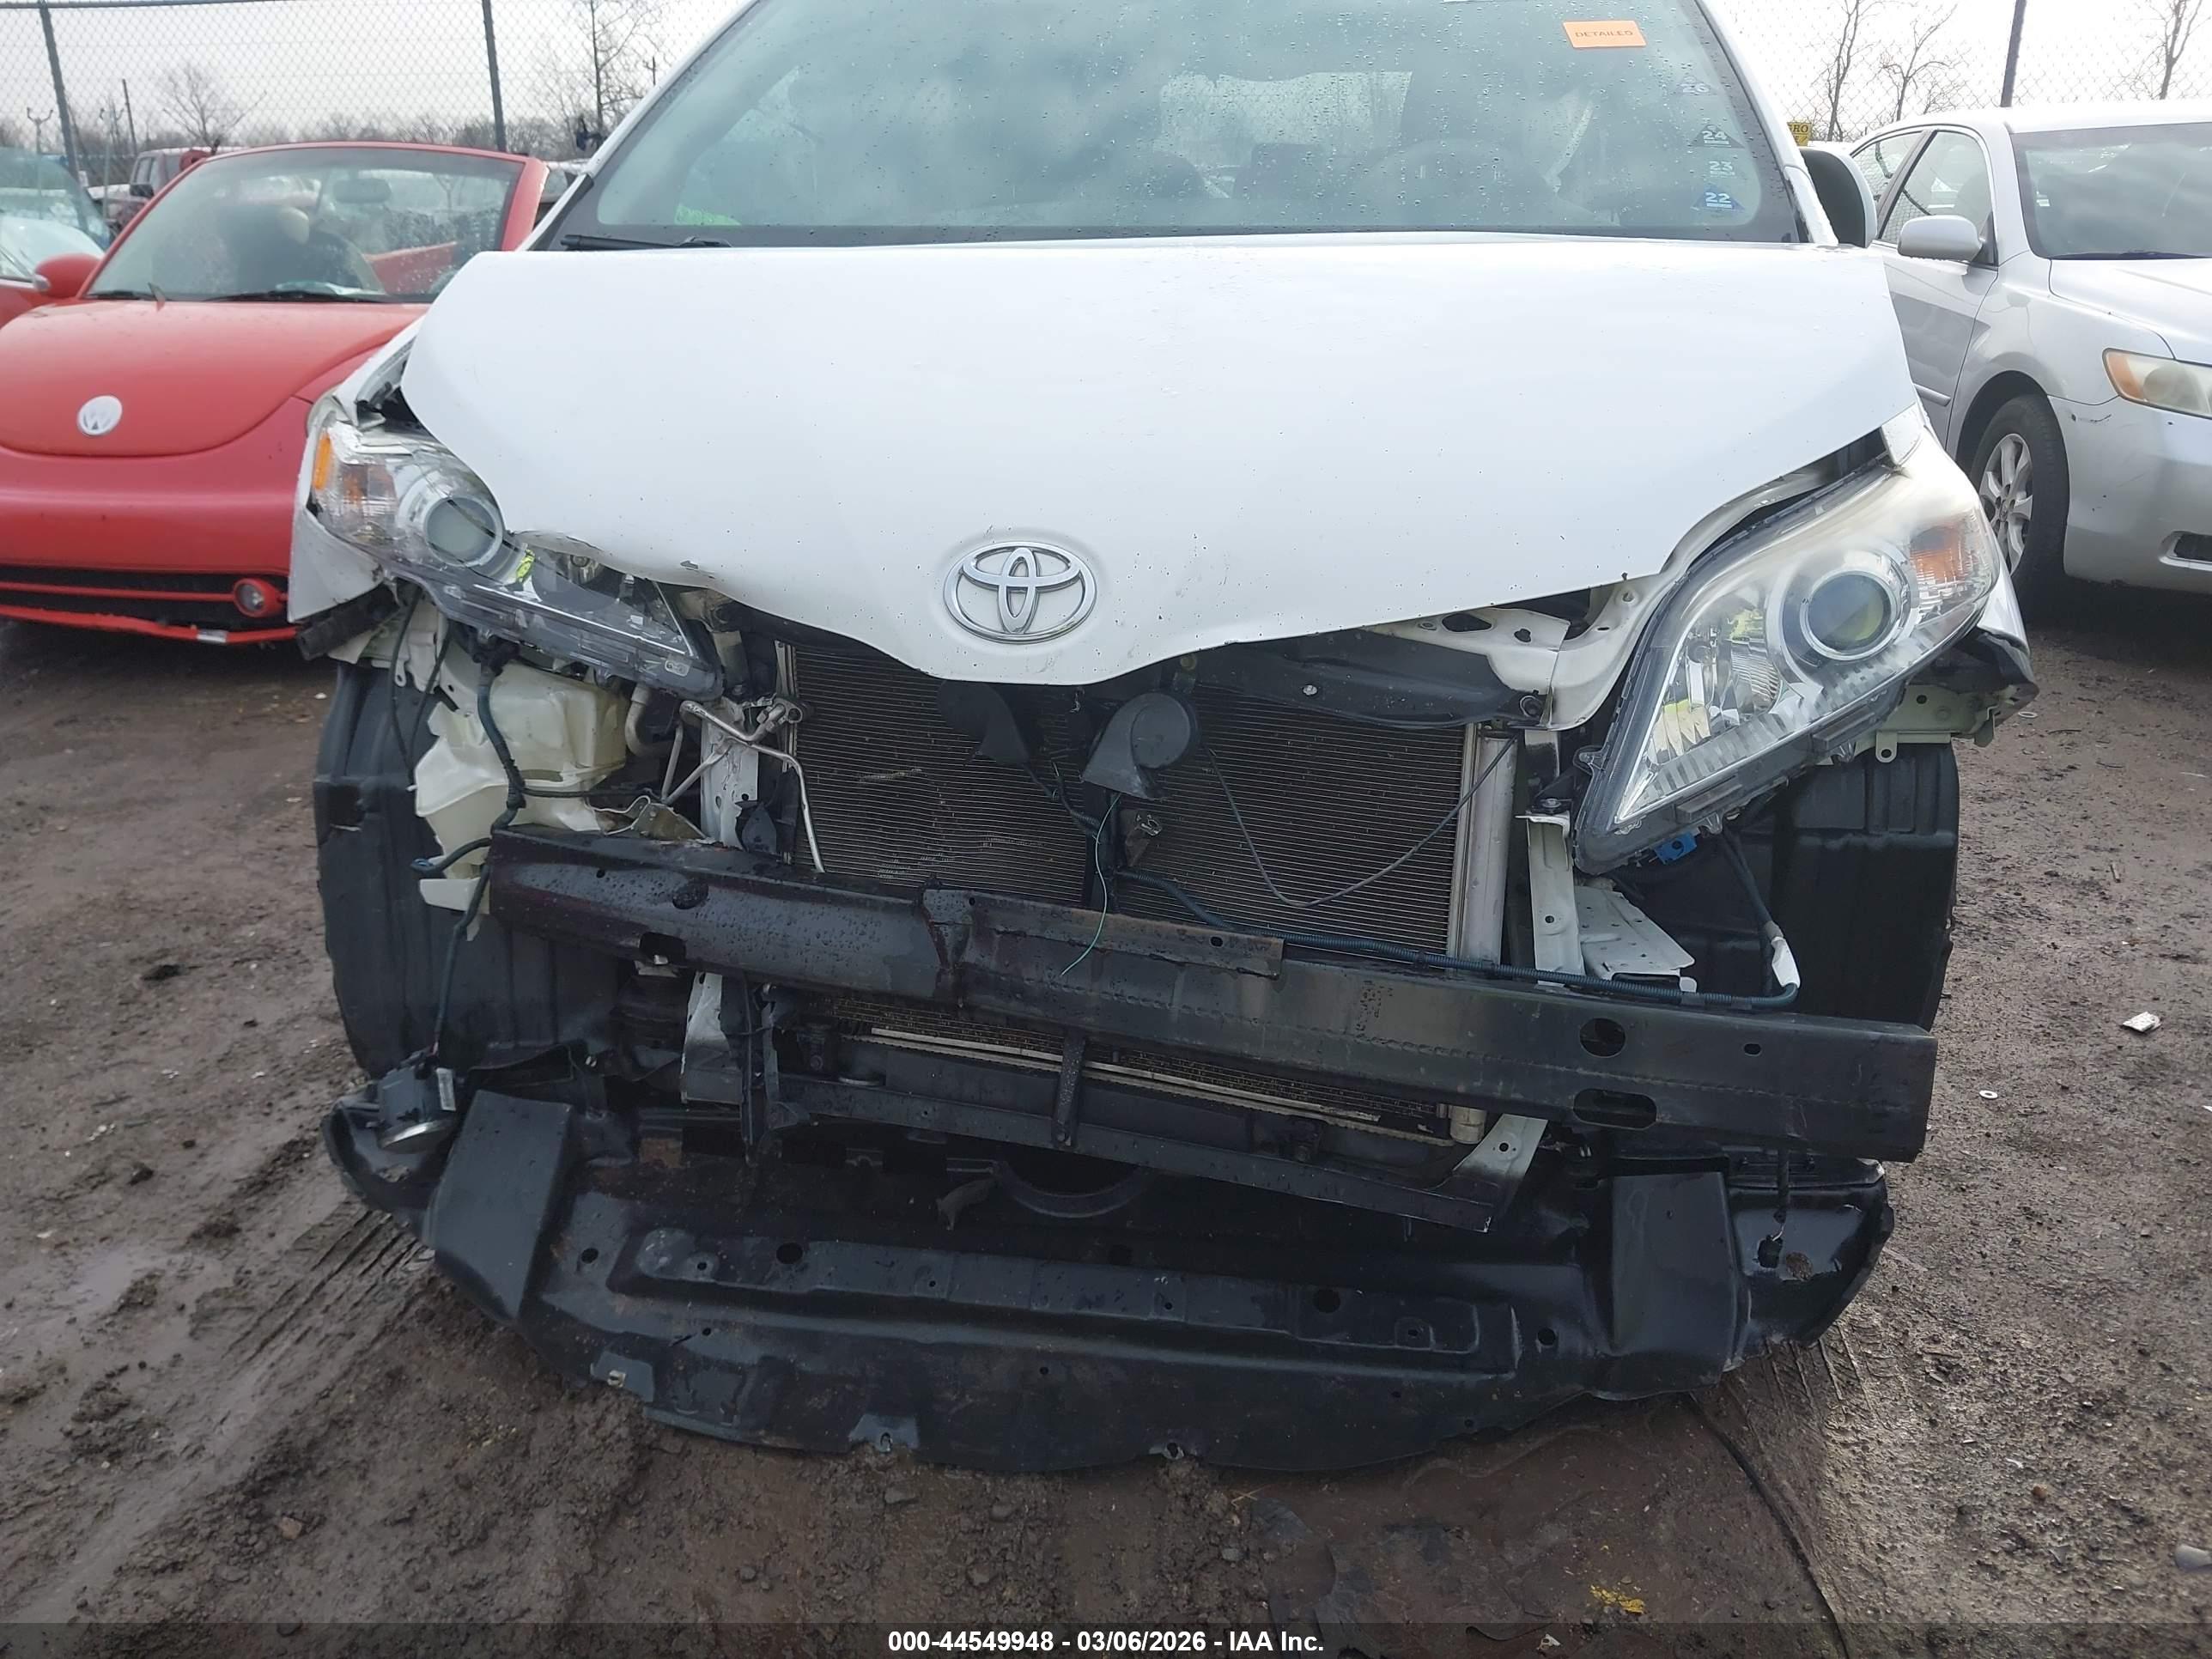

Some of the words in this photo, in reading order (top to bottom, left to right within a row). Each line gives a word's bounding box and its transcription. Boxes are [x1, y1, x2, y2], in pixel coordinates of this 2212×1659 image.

[1702, 131, 1728, 140] 24
[1709, 161, 1733, 171] 23
[1705, 191, 1732, 204] 22
